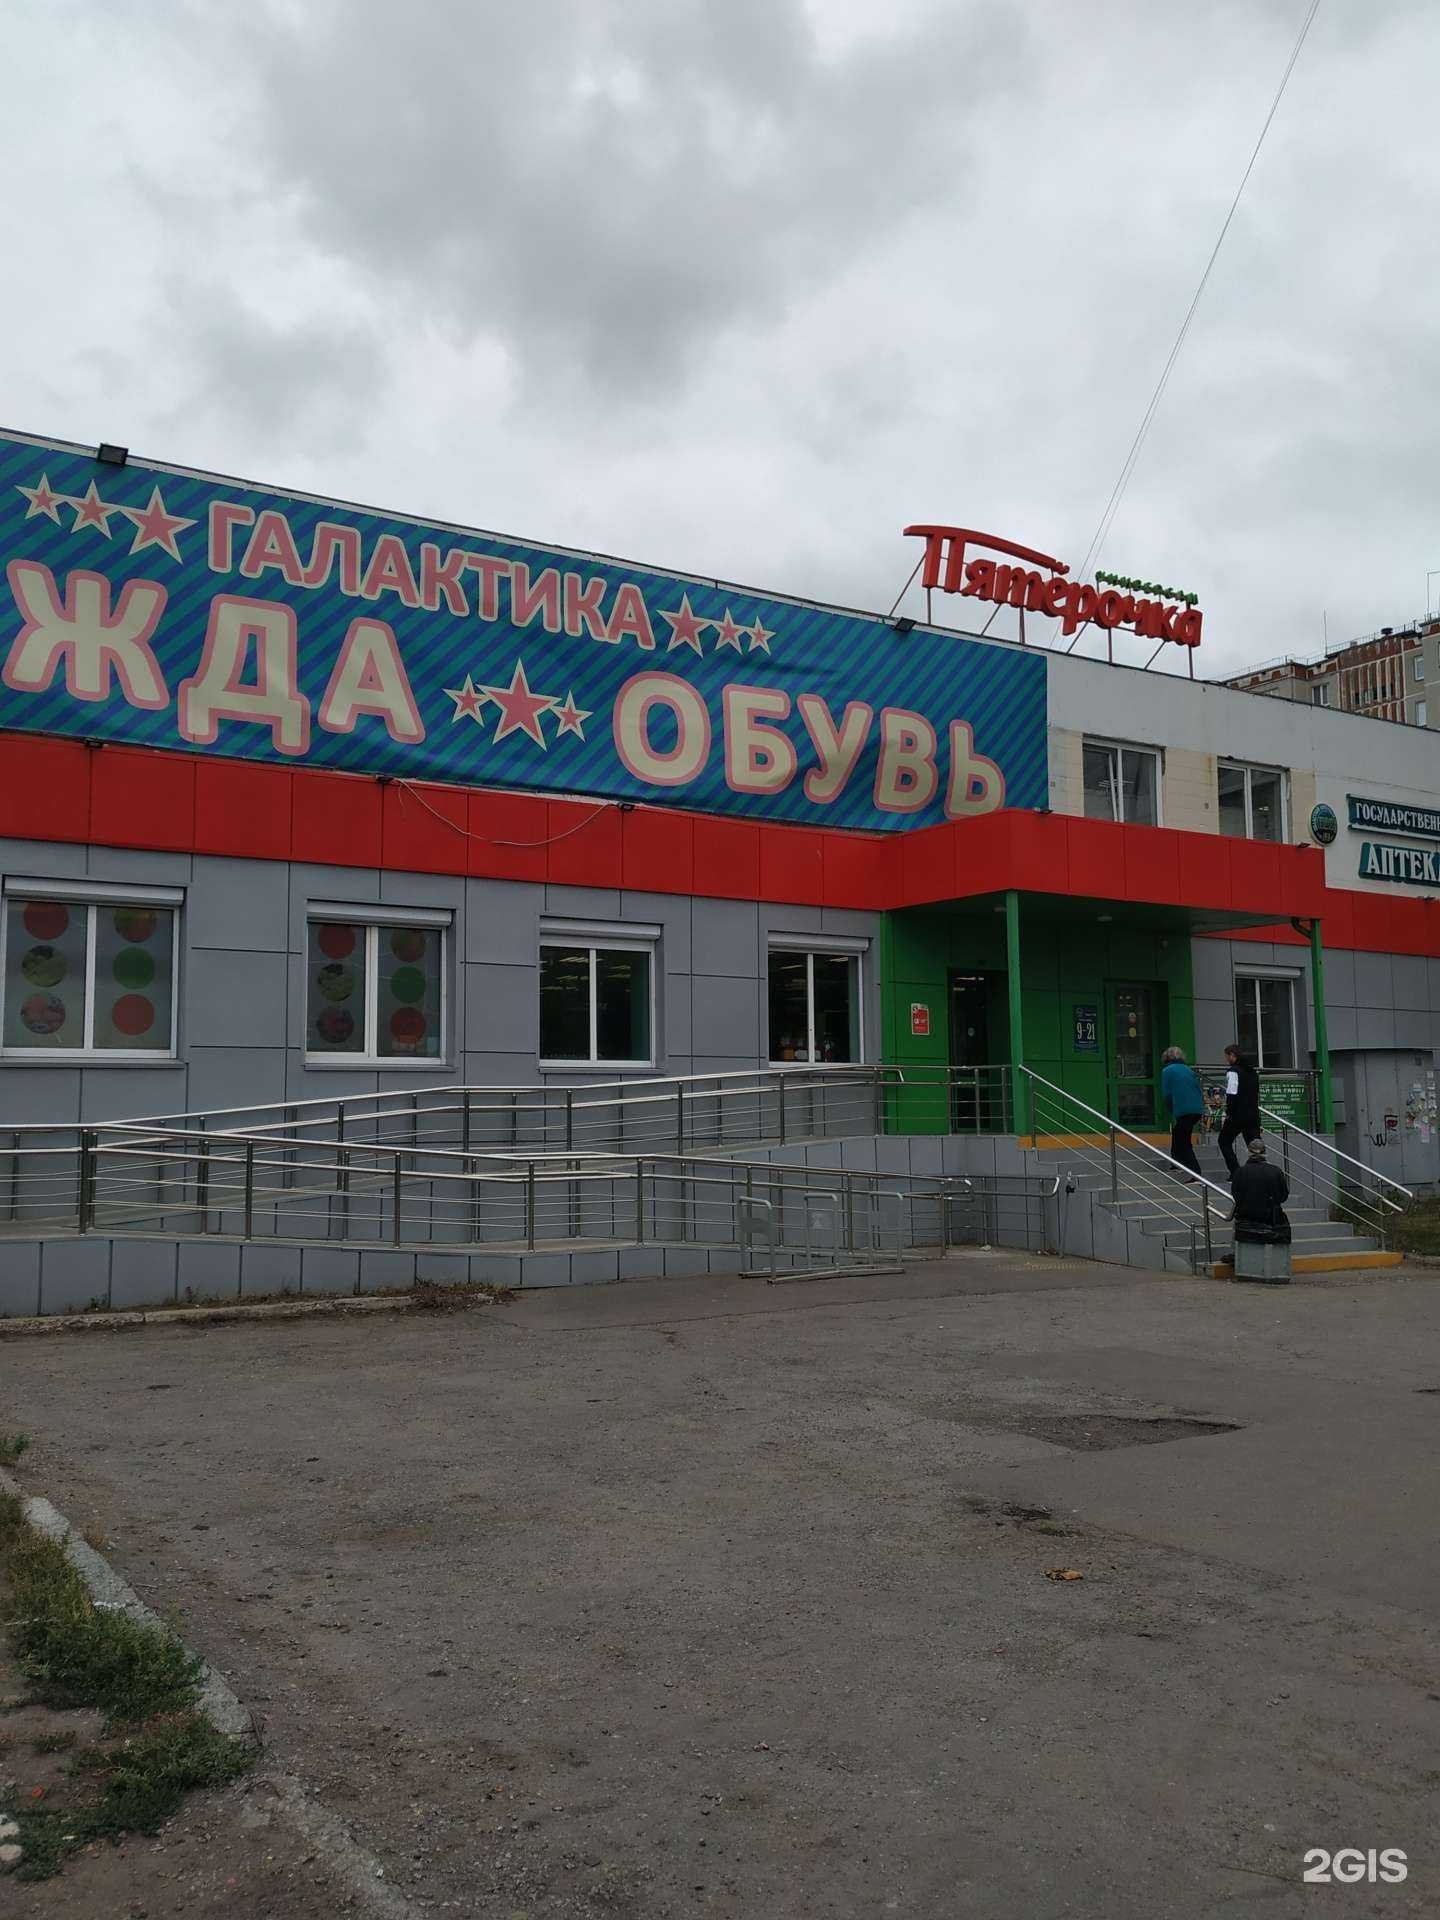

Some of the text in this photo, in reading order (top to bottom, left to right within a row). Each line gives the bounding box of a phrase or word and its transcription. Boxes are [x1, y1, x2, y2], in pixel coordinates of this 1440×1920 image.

[208, 500, 657, 651] ГАЛАКТИКА
[903, 525, 1203, 647] Пятерочка
[3, 559, 1006, 820] ЖДА ОБУВЬ
[1366, 844, 1440, 883] АПТЕК
